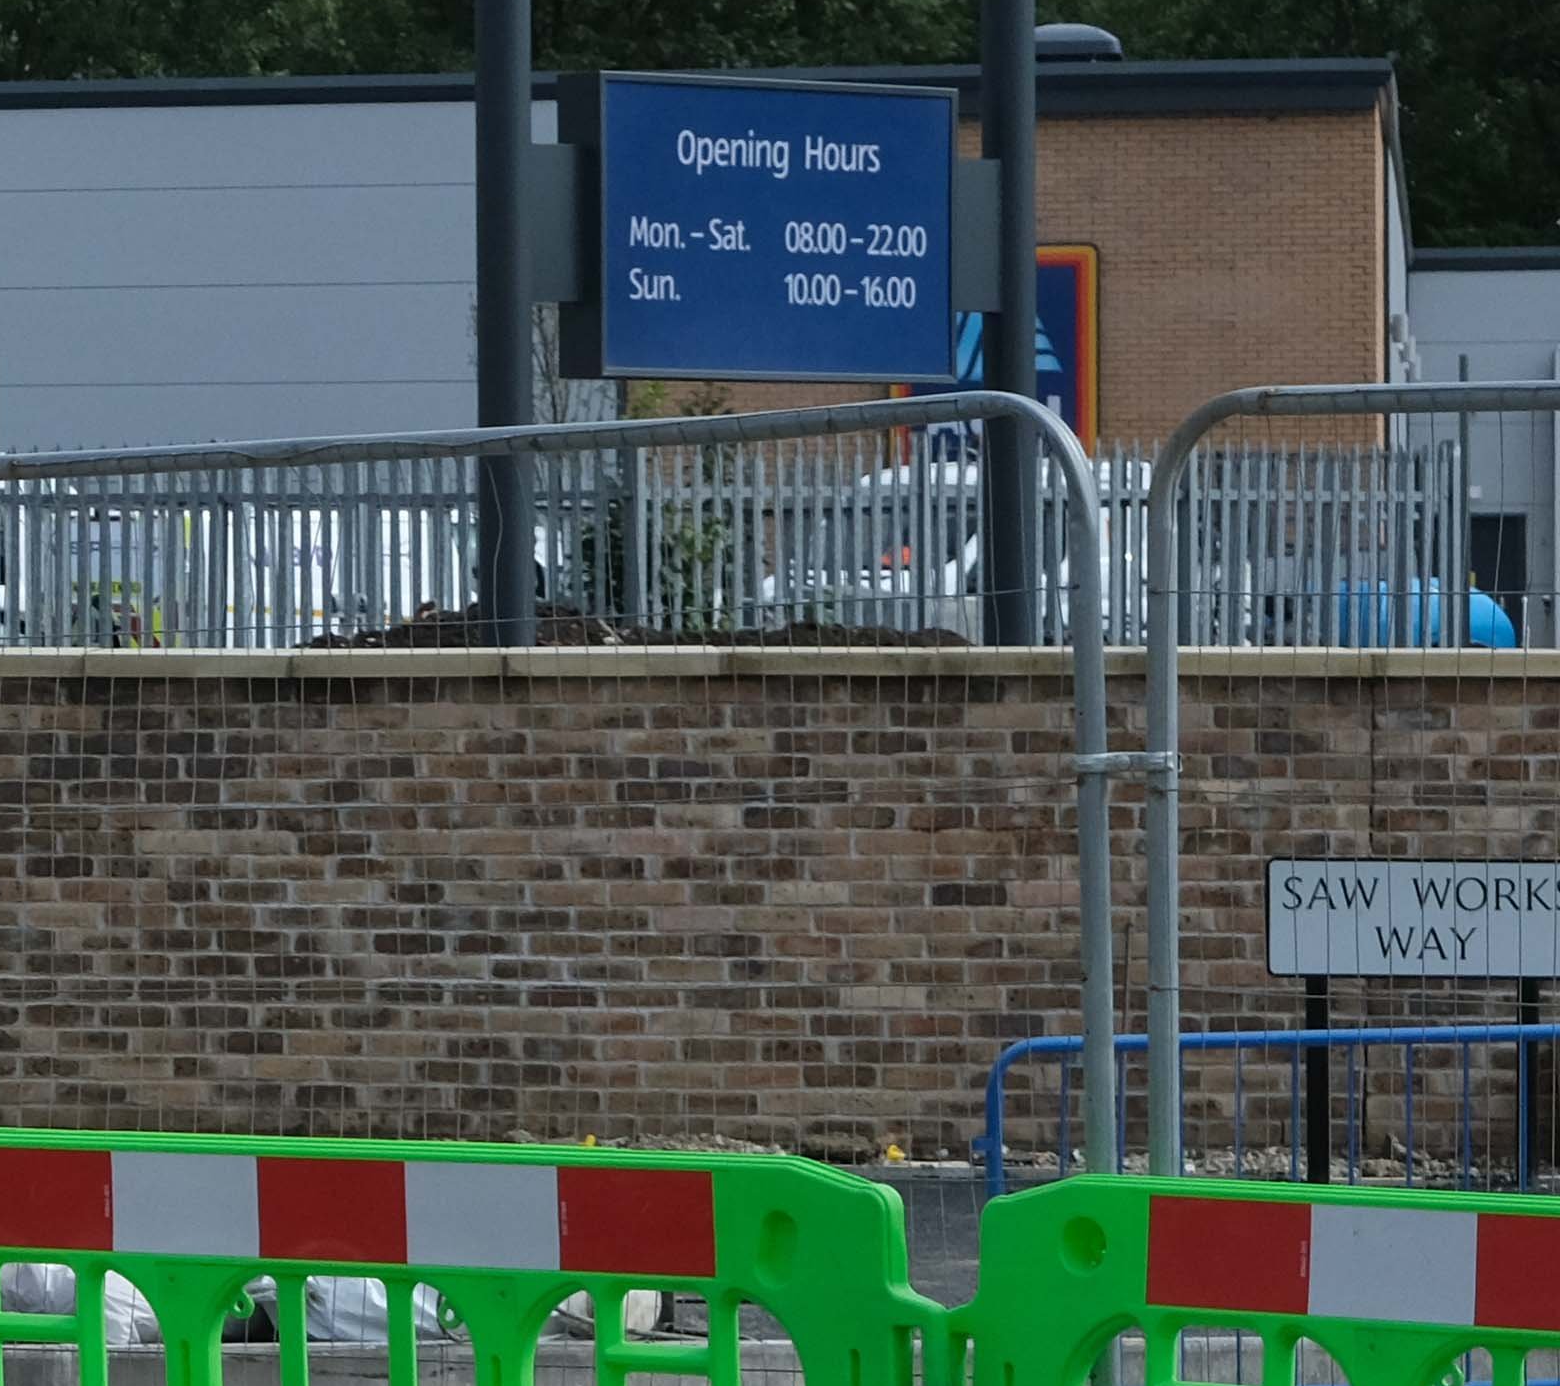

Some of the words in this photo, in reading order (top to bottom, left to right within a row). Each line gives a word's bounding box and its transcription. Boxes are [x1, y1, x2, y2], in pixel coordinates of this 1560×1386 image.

[676, 129, 790, 179] Opening
[805, 135, 881, 172] Hours
[629, 267, 681, 301] Sun.
[1282, 876, 1379, 910] SAW
[1412, 876, 1560, 911] WORK
[1375, 925, 1477, 961] WAY
